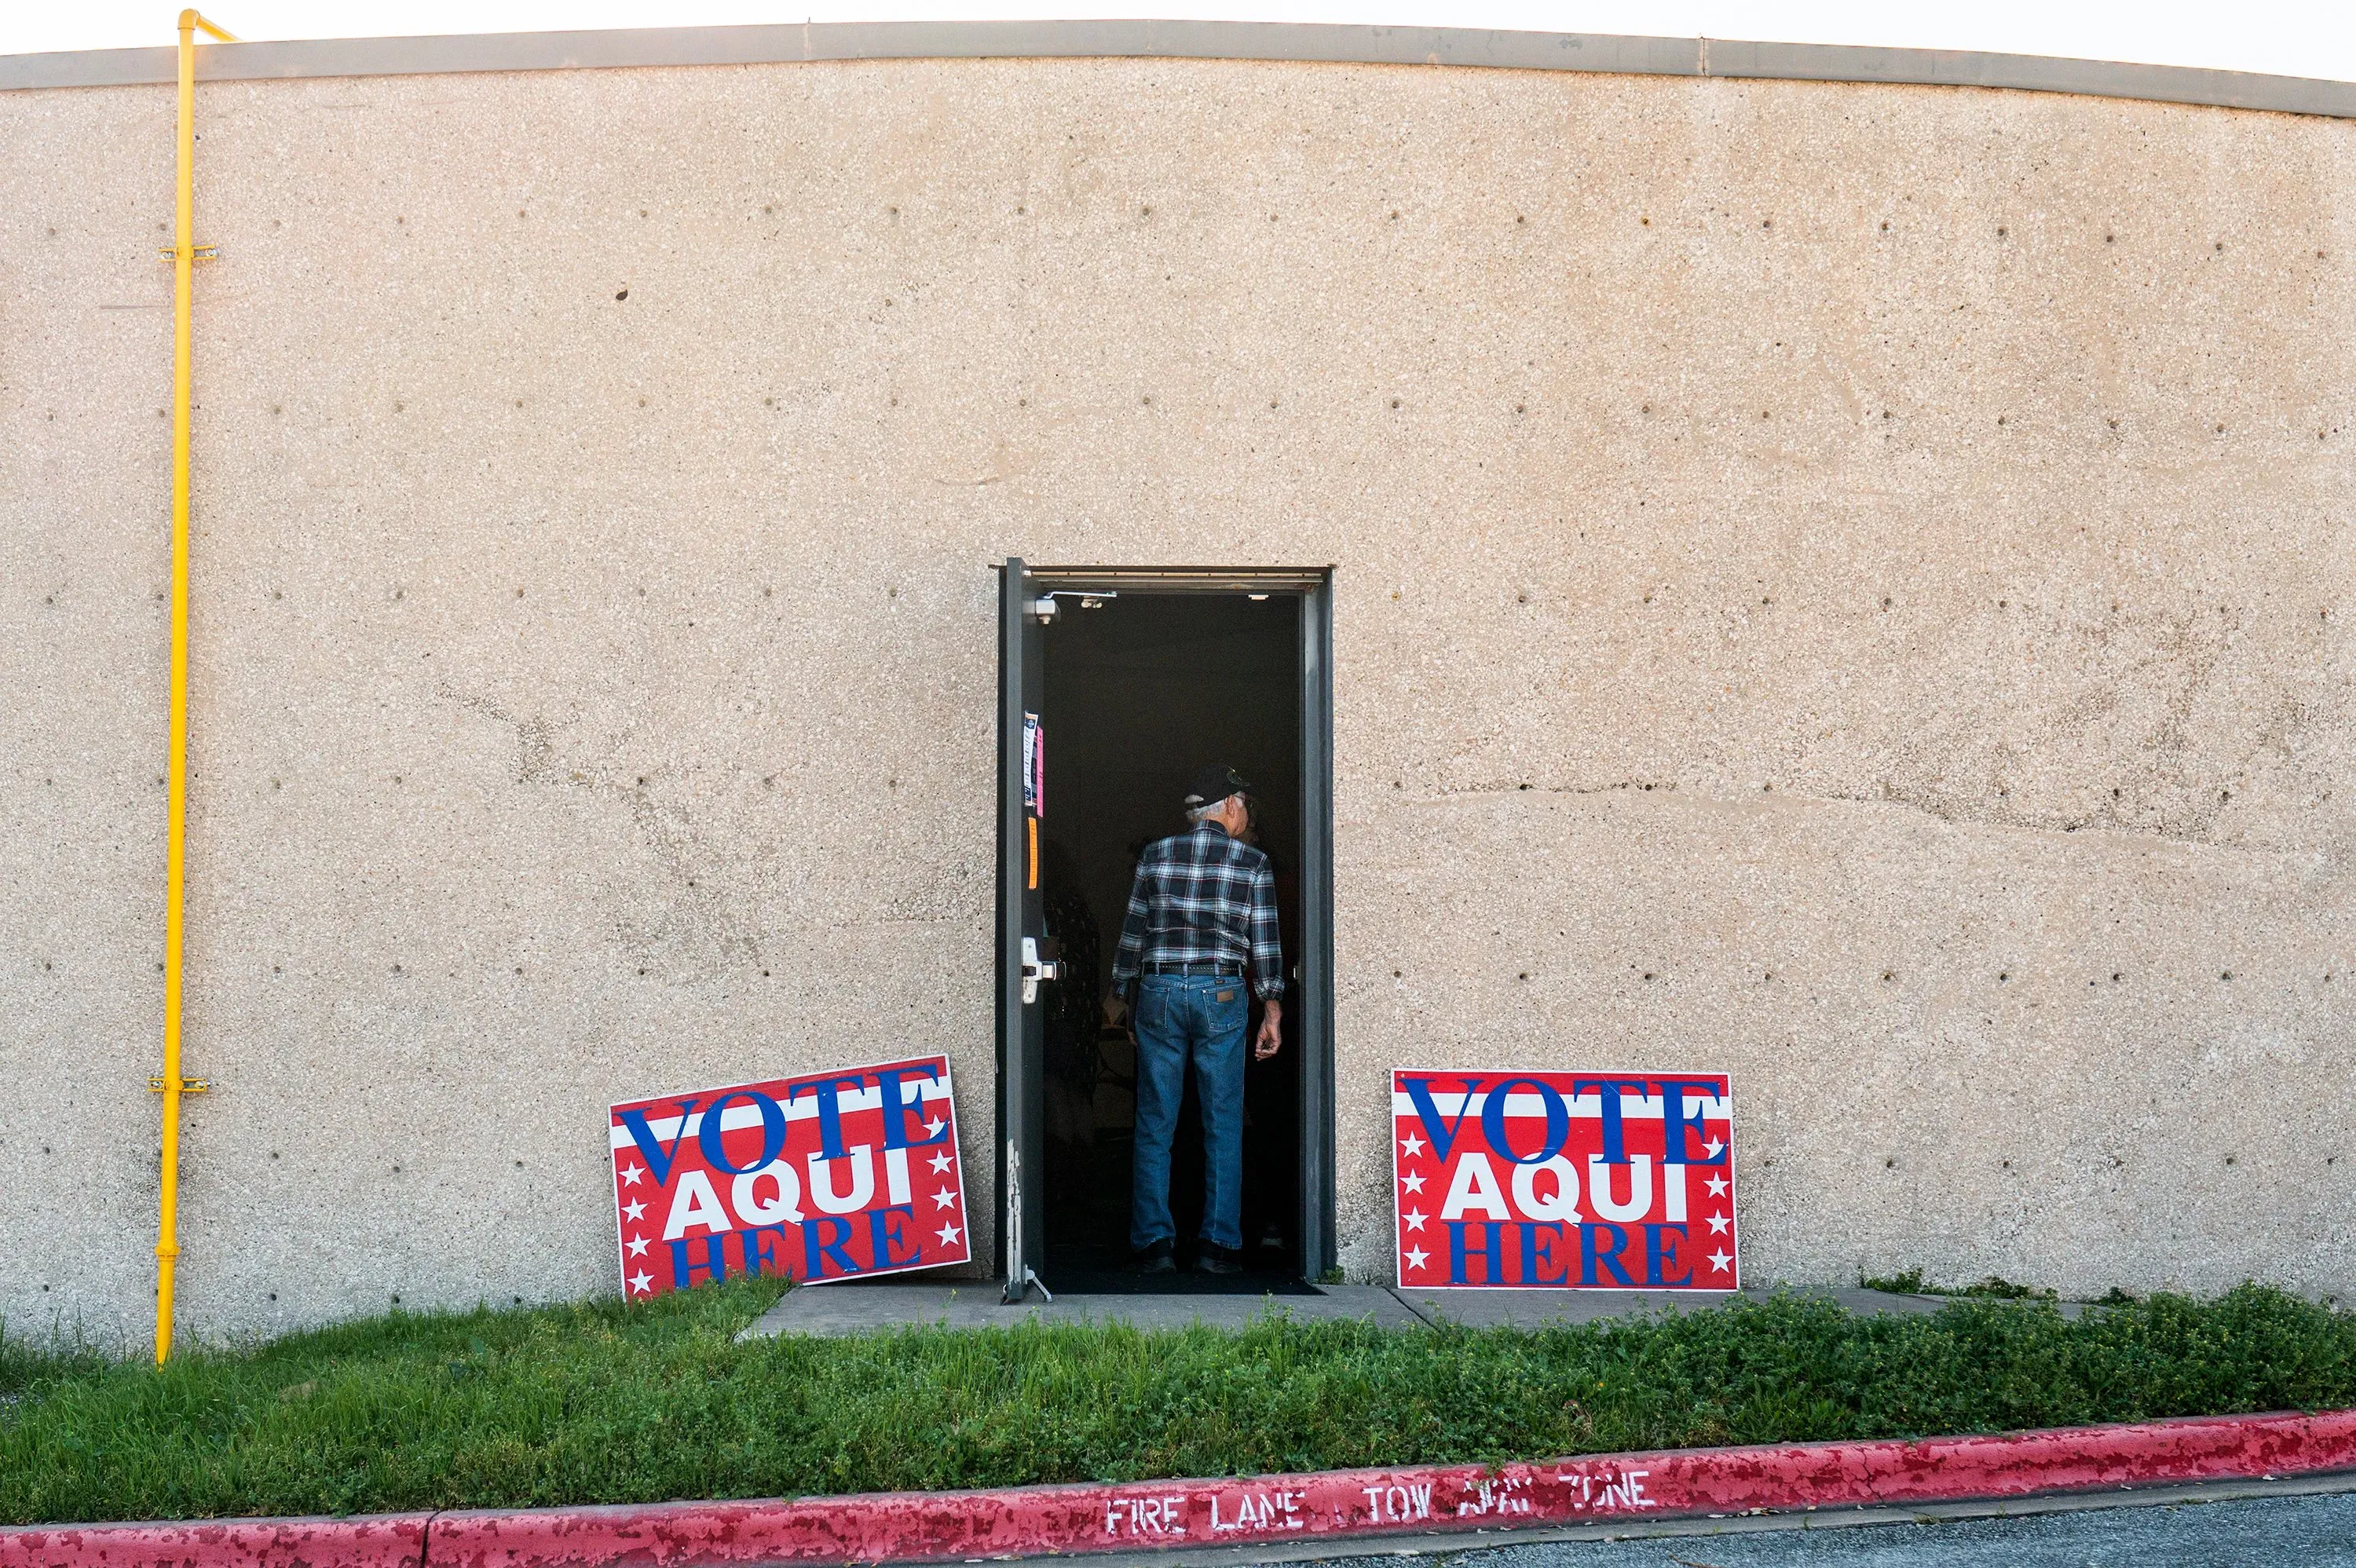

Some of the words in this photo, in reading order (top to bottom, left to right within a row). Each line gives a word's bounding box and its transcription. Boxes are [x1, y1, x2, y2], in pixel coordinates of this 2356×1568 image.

[613, 1065, 949, 1187] VOTE
[1398, 1078, 1729, 1165] VOTE
[661, 1144, 913, 1242] AQUI
[1440, 1152, 1688, 1228] AQUI
[664, 1205, 920, 1290] HERE
[1443, 1221, 1693, 1286] HERE
[1105, 1496, 1186, 1535] FIRE
[1210, 1492, 1307, 1532] LANE
[1363, 1483, 1432, 1522] TOW
